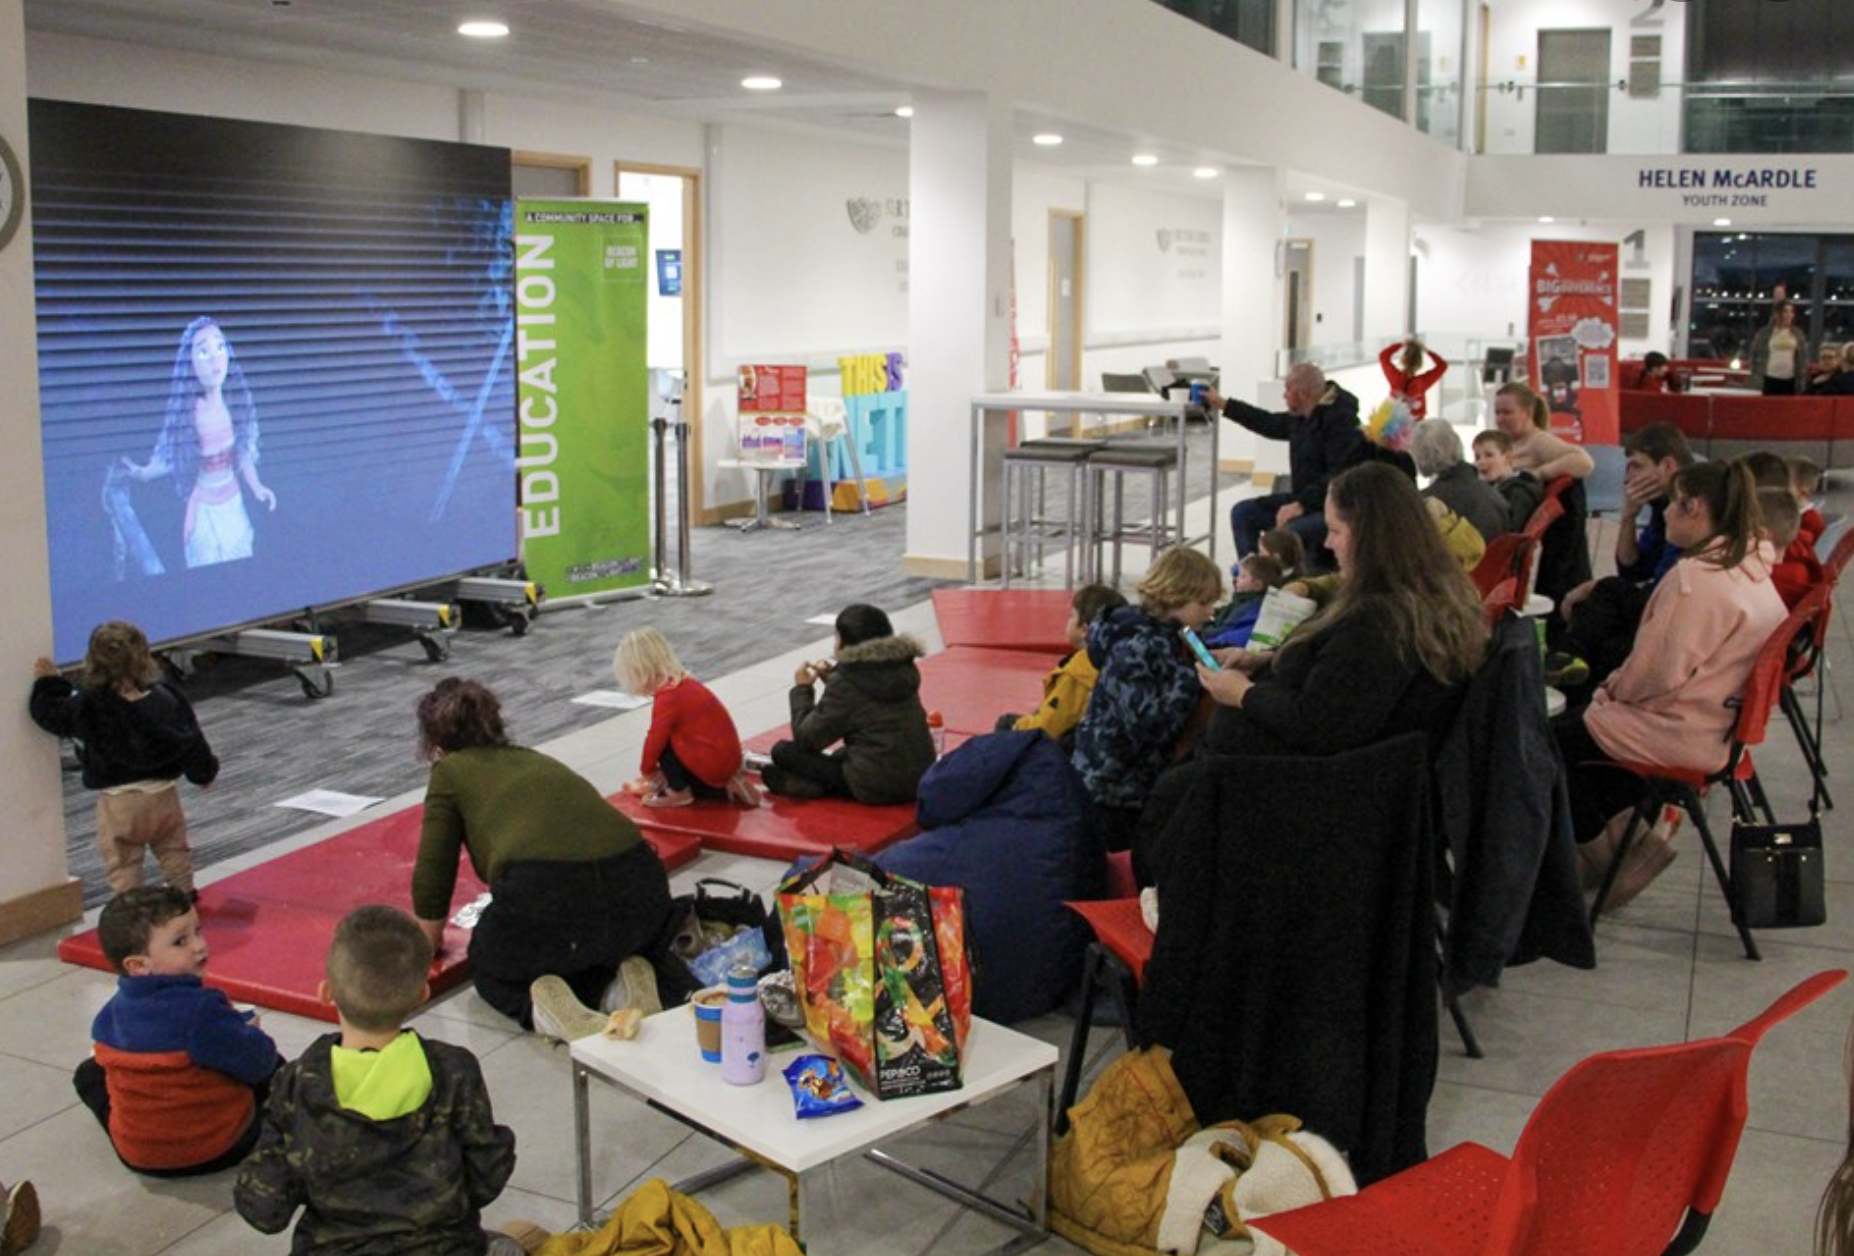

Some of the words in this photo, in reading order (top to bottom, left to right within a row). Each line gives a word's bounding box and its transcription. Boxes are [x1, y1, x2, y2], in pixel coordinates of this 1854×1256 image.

[1638, 169, 1706, 188] HELEN
[1712, 169, 1817, 189] McARDLE
[1682, 194, 1727, 207] YOUTH
[1731, 194, 1768, 207] ZONE
[535, 213, 586, 223] COMMUNITY
[588, 213, 614, 222] SPACE
[1622, 229, 1650, 270] 1
[515, 234, 560, 538] EDUCATION
[837, 351, 888, 397] THIS
[886, 352, 904, 393] IS
